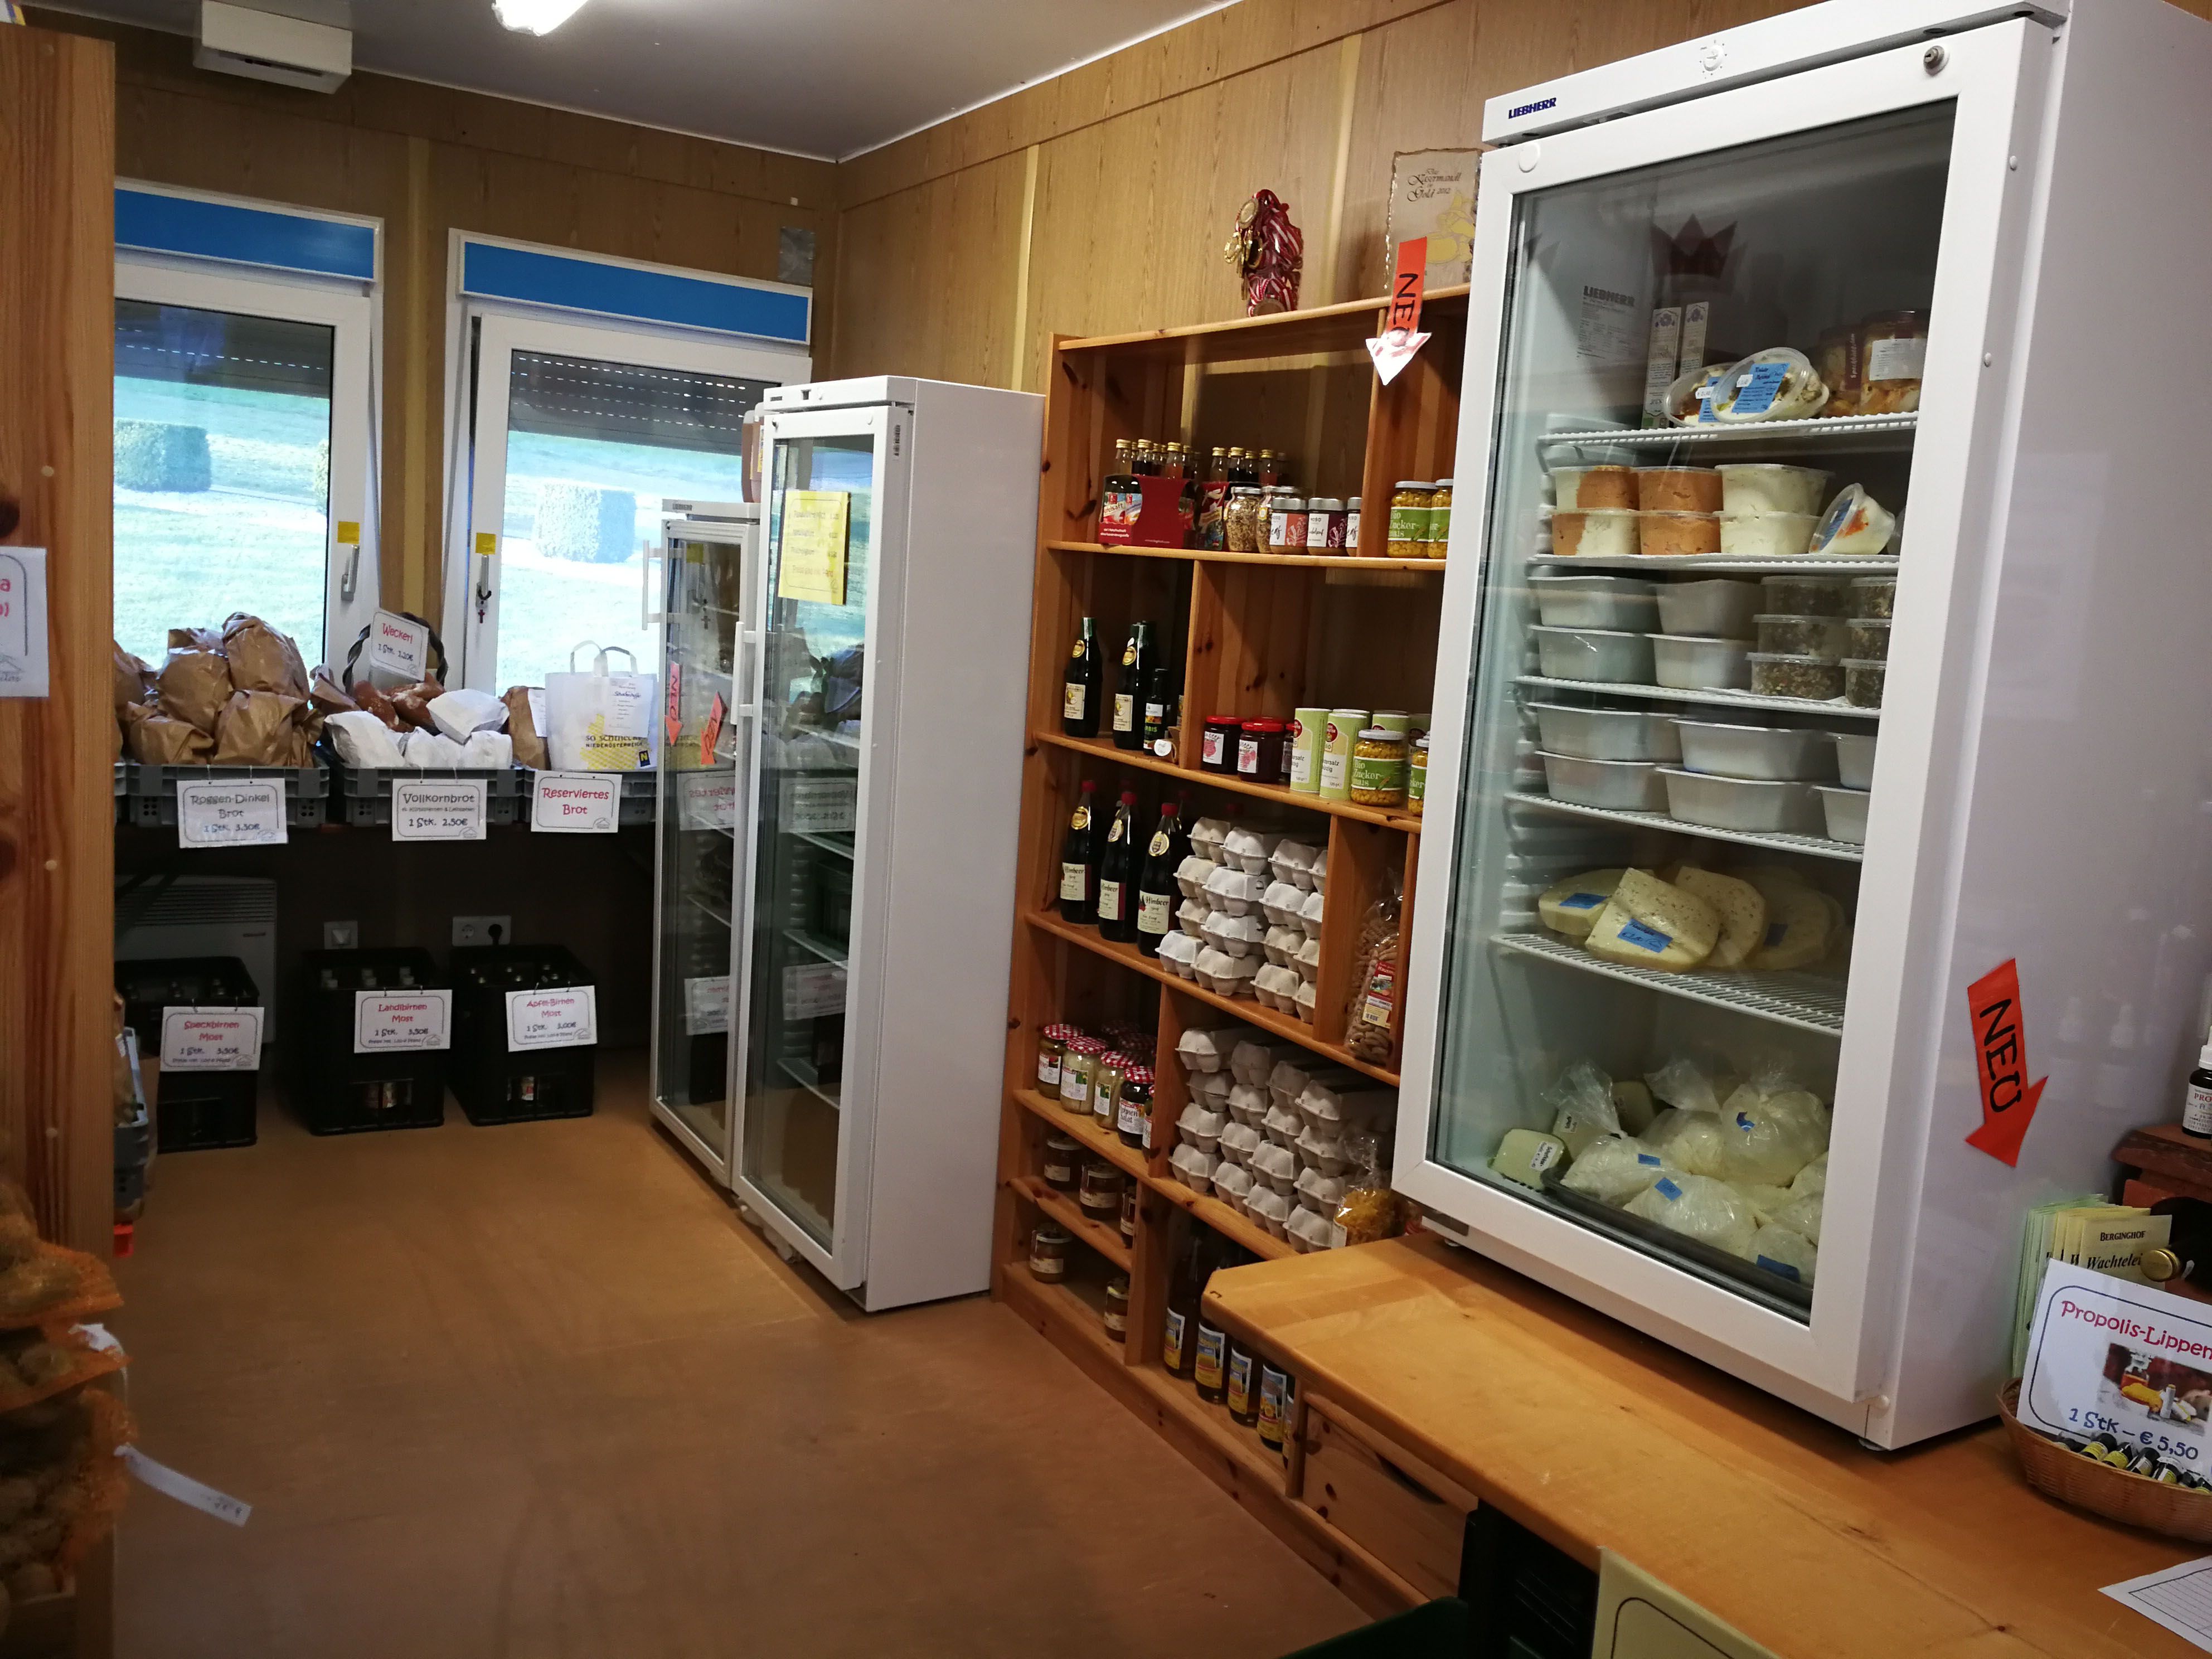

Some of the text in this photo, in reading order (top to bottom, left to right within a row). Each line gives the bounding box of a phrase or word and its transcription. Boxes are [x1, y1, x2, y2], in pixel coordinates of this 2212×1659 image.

[1508, 98, 1556, 119] LIEBHERR
[1354, 759, 1365, 769] Bio
[1353, 768, 1384, 780] Zucker-
[190, 794, 270, 805] Roggen-Dinkel
[403, 793, 475, 804] Vollkornbrot
[542, 788, 609, 800] Reserviertes
[218, 809, 244, 819] Brot
[562, 804, 588, 815] Brot
[409, 818, 414, 827] 1
[1146, 896, 1169, 906] Himbeer
[392, 1015, 414, 1023] Most
[184, 1021, 240, 1030] Speckbirnen
[199, 1033, 224, 1041] Most
[1980, 998, 2022, 1113] NEU
[2101, 1230, 2146, 1241] BERGINGHOF
[2061, 1300, 2212, 1360] Propolis-Lippen
[2069, 1408, 2078, 1422] 1
[2083, 1411, 2119, 1433] Stk
[2157, 1436, 2199, 1460] 5,50
